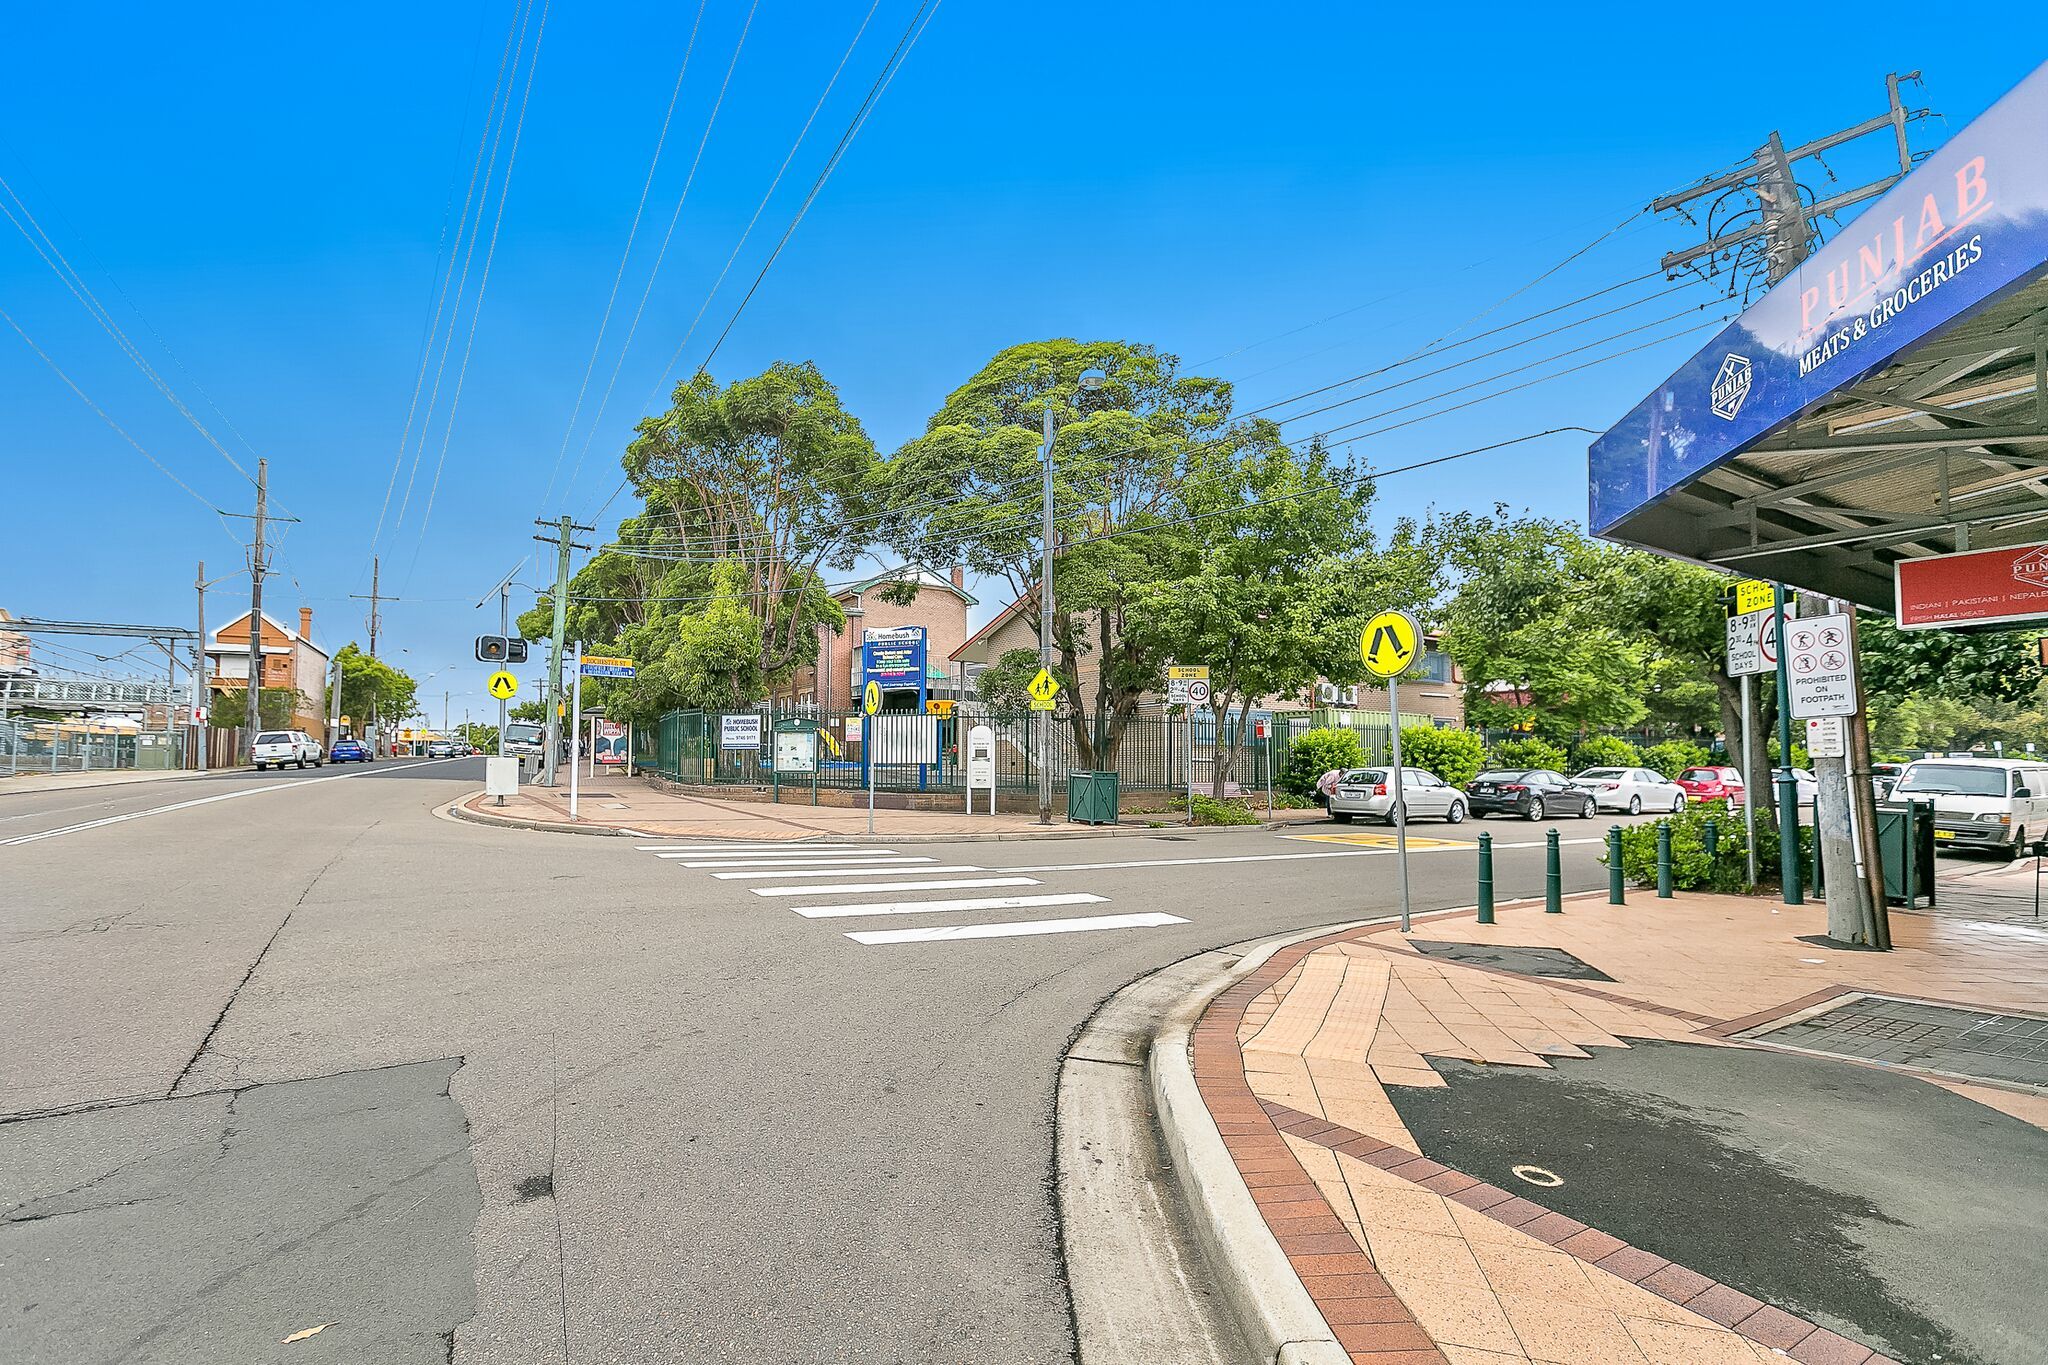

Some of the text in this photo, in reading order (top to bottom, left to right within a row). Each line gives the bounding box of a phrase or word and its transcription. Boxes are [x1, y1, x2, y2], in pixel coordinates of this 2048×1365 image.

[1800, 155, 1988, 334] PUNJAB
[1798, 234, 1983, 379] MEATS & GROCERIES
[1711, 366, 1752, 406] PUNJAB
[1746, 592, 1773, 608] ZONE
[1910, 602, 1942, 611] INDIAN
[1952, 596, 1999, 606] PAKISTANI
[1960, 609, 1986, 617] MEATS
[877, 631, 909, 639] Homebush
[1731, 650, 1756, 662] SCHOOL
[586, 658, 619, 666] ROCHESTER
[1734, 661, 1754, 671] DAYS
[1796, 675, 1847, 685] PROHIBITED
[1192, 686, 1206, 696] 40
[1801, 694, 1845, 704] FOOTPATH
